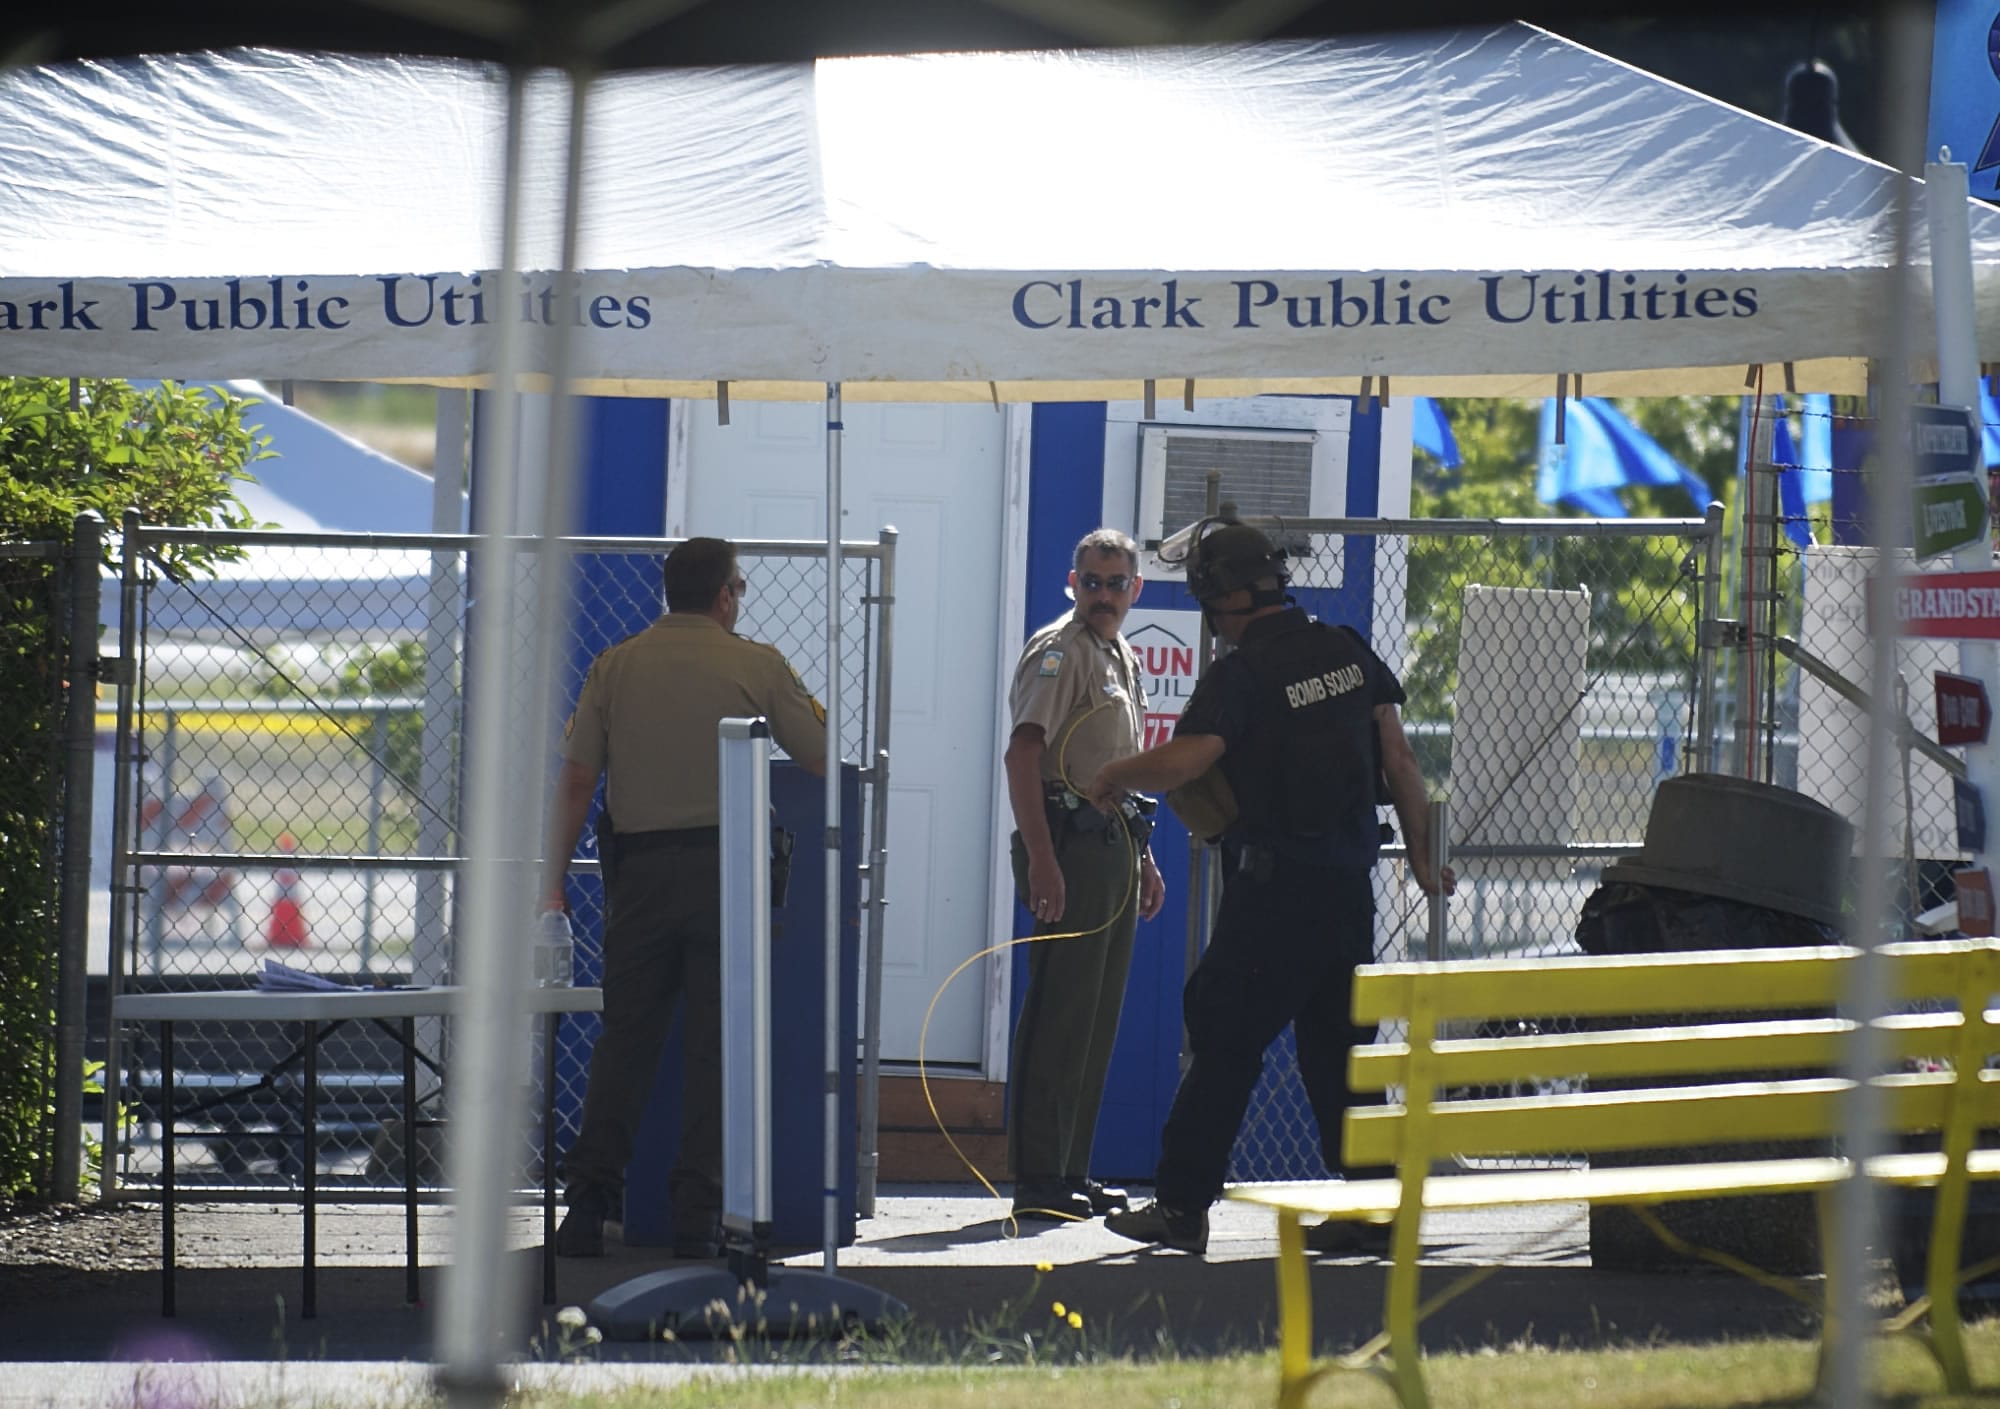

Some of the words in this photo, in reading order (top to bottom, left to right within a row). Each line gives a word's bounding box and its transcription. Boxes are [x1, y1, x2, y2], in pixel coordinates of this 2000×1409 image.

[128, 277, 350, 331] Public
[376, 273, 652, 329] Utiities
[1012, 279, 1205, 329] Clark
[1230, 276, 1451, 329] Public
[1478, 272, 1759, 325] Utilities
[1285, 677, 1327, 709] BOMB
[1323, 663, 1365, 697] SQUAD
